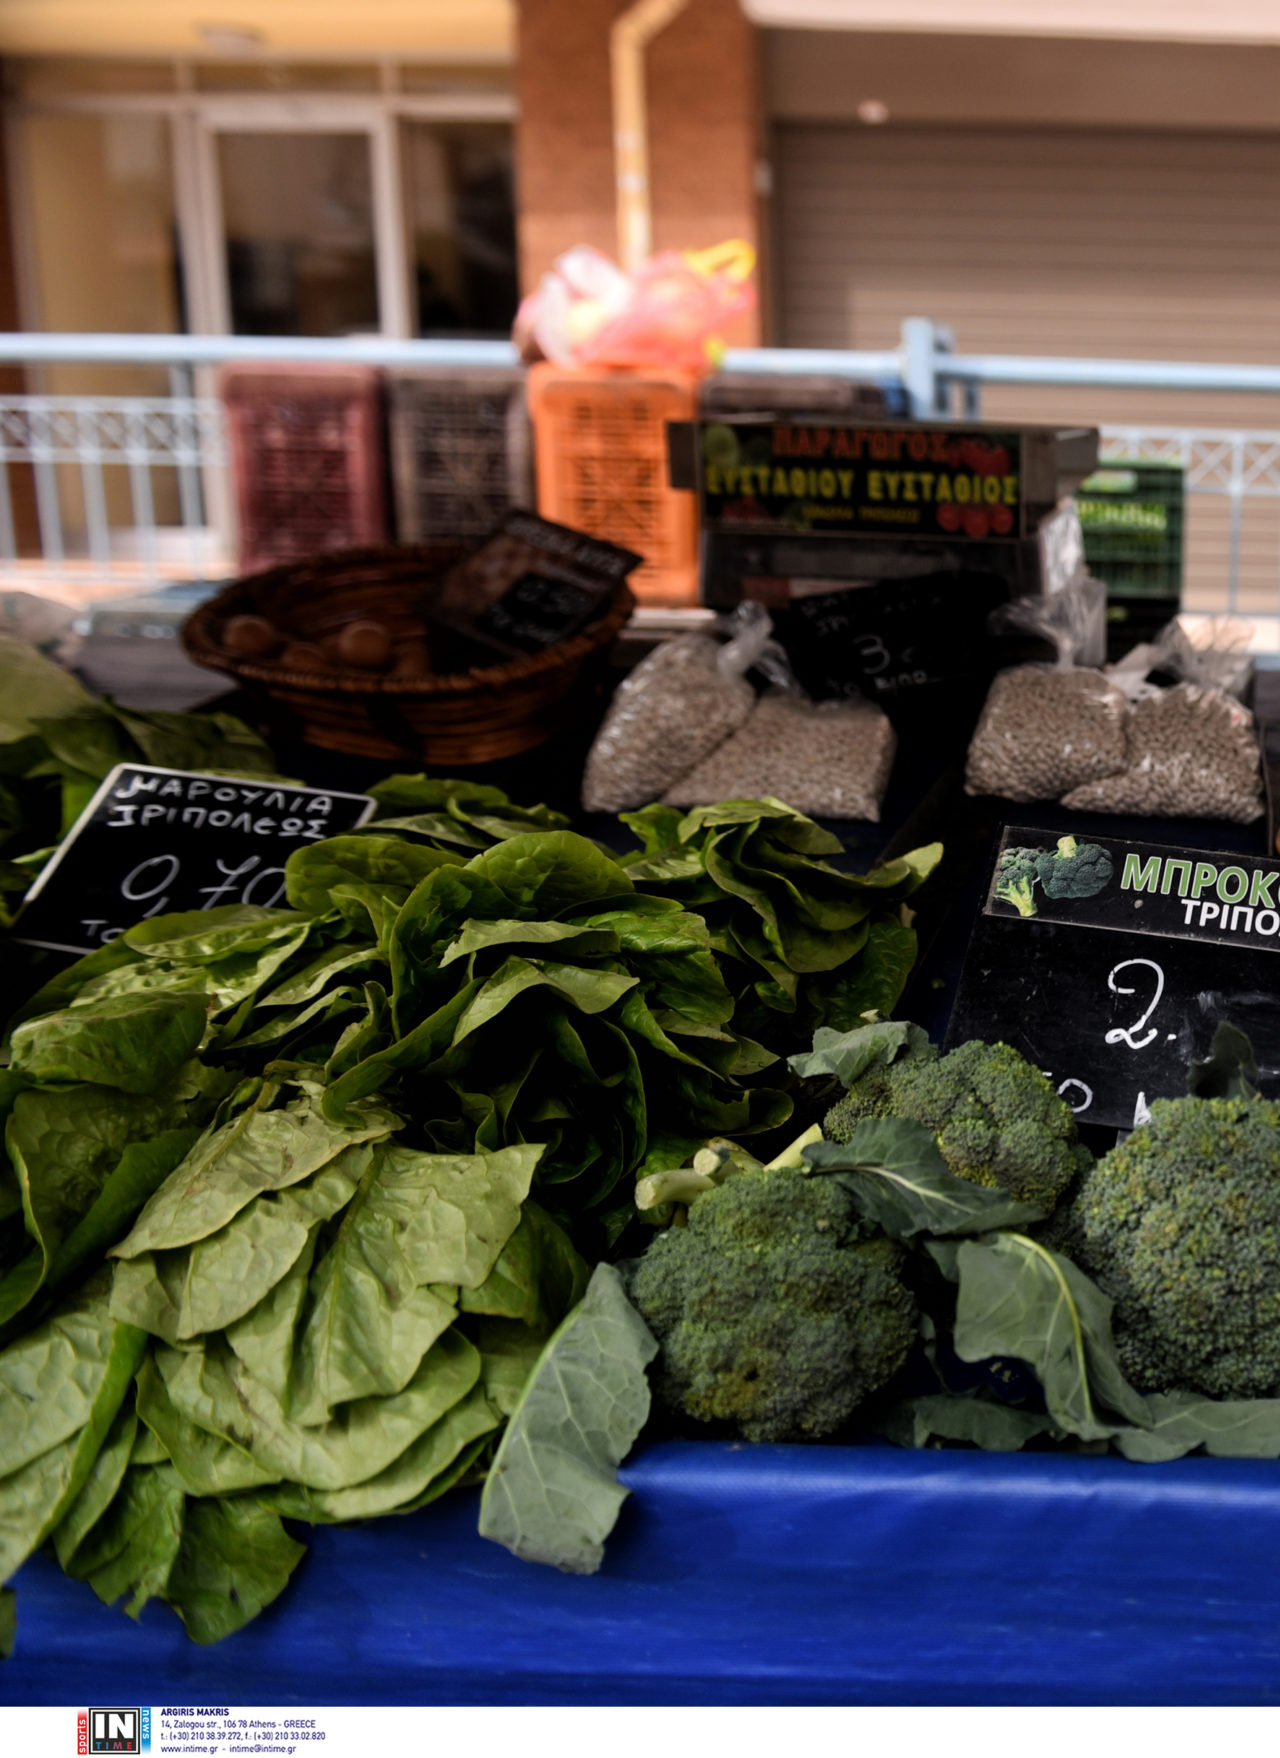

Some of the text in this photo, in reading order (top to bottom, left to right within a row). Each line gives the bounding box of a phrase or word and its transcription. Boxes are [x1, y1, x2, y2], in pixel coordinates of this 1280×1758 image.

[773, 428, 947, 462] ΠΑΡΑΓΩΓΟΣ
[705, 465, 1017, 505] ΕΥΣΤΑΘΙΟΥ ΕΥΣΤΑΘΙΟΣ
[115, 775, 334, 816] ΜΑΡΟΥΛΙΑ
